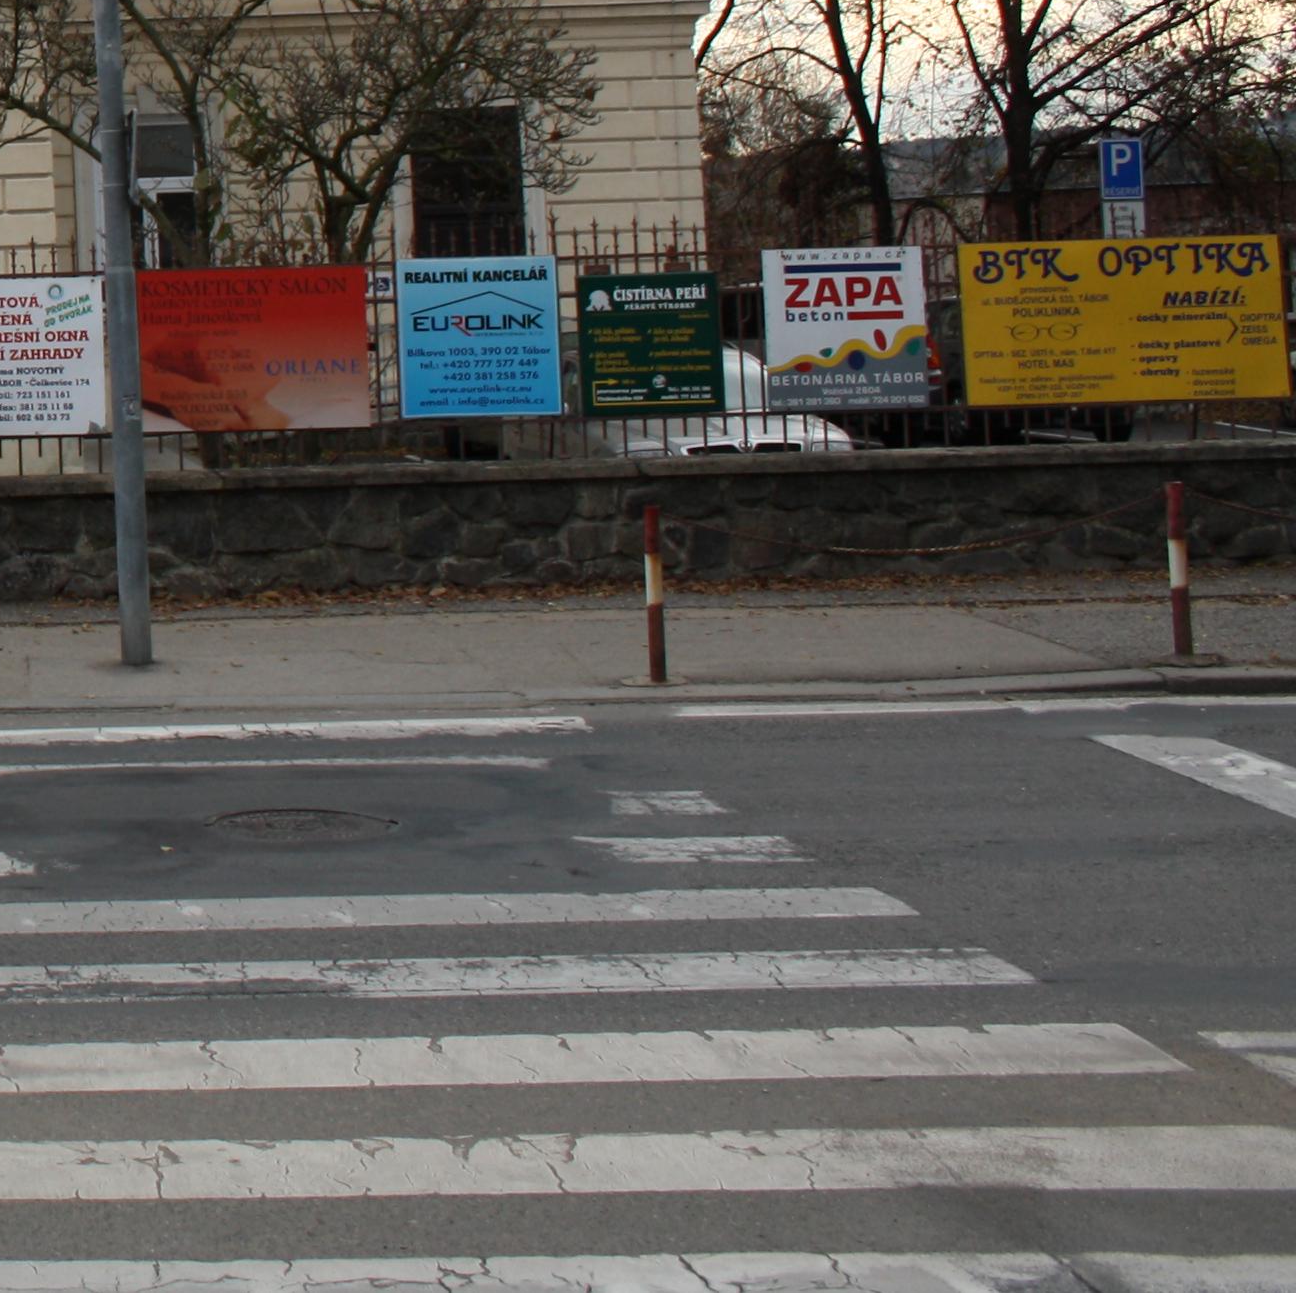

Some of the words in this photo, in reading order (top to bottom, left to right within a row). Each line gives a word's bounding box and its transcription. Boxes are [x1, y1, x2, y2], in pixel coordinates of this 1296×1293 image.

[1111, 143, 1132, 176] P
[973, 247, 1079, 284] BTK
[1098, 242, 1270, 277] OPTIKA
[405, 268, 467, 284] REALITNÍ
[472, 265, 548, 282] KANCELÁŘ
[280, 276, 347, 295] SALON
[613, 285, 673, 301] ČISTÍRNA
[675, 283, 706, 299] PEŘÍ
[784, 276, 903, 308] ZAPA
[1163, 285, 1246, 306] NABÍZÍ:
[786, 310, 844, 323] beton
[1012, 307, 1081, 318] POLIKLINIKA
[1136, 313, 1168, 323] čočky
[1240, 313, 1282, 323] DIOPTRA
[413, 314, 544, 336] EUROLINK
[1241, 324, 1268, 334] ZEISS
[45, 330, 89, 342] OKNA
[1241, 336, 1277, 346] OMEGA
[1138, 340, 1170, 350] čočky
[1174, 339, 1222, 350] plastové
[10, 348, 84, 361] ZAHRADY
[449, 348, 478, 357] 1003,
[481, 347, 501, 355] 390
[505, 346, 518, 355] 02
[522, 345, 551, 355] Tábor
[420, 361, 439, 369] tel.:
[443, 359, 470, 369] +420
[474, 359, 492, 367] 777
[496, 358, 514, 367] 577
[518, 358, 538, 367] 449
[1018, 359, 1050, 369] HOTEL
[1053, 358, 1075, 368] MAS
[1139, 355, 1178, 364] opravy
[16, 365, 64, 375] NOVOTNÝ
[265, 357, 363, 377] ORLANE
[1140, 367, 1180, 377] obruby
[443, 371, 471, 380] +420
[474, 371, 492, 380] 381
[496, 371, 516, 380] 258
[520, 370, 539, 379] 576
[771, 372, 868, 386] BETONÁRNA
[873, 370, 925, 383] TÁBOR
[16, 391, 32, 399] 723
[420, 397, 448, 406] email
[458, 396, 545, 407] info@eurolink.cz
